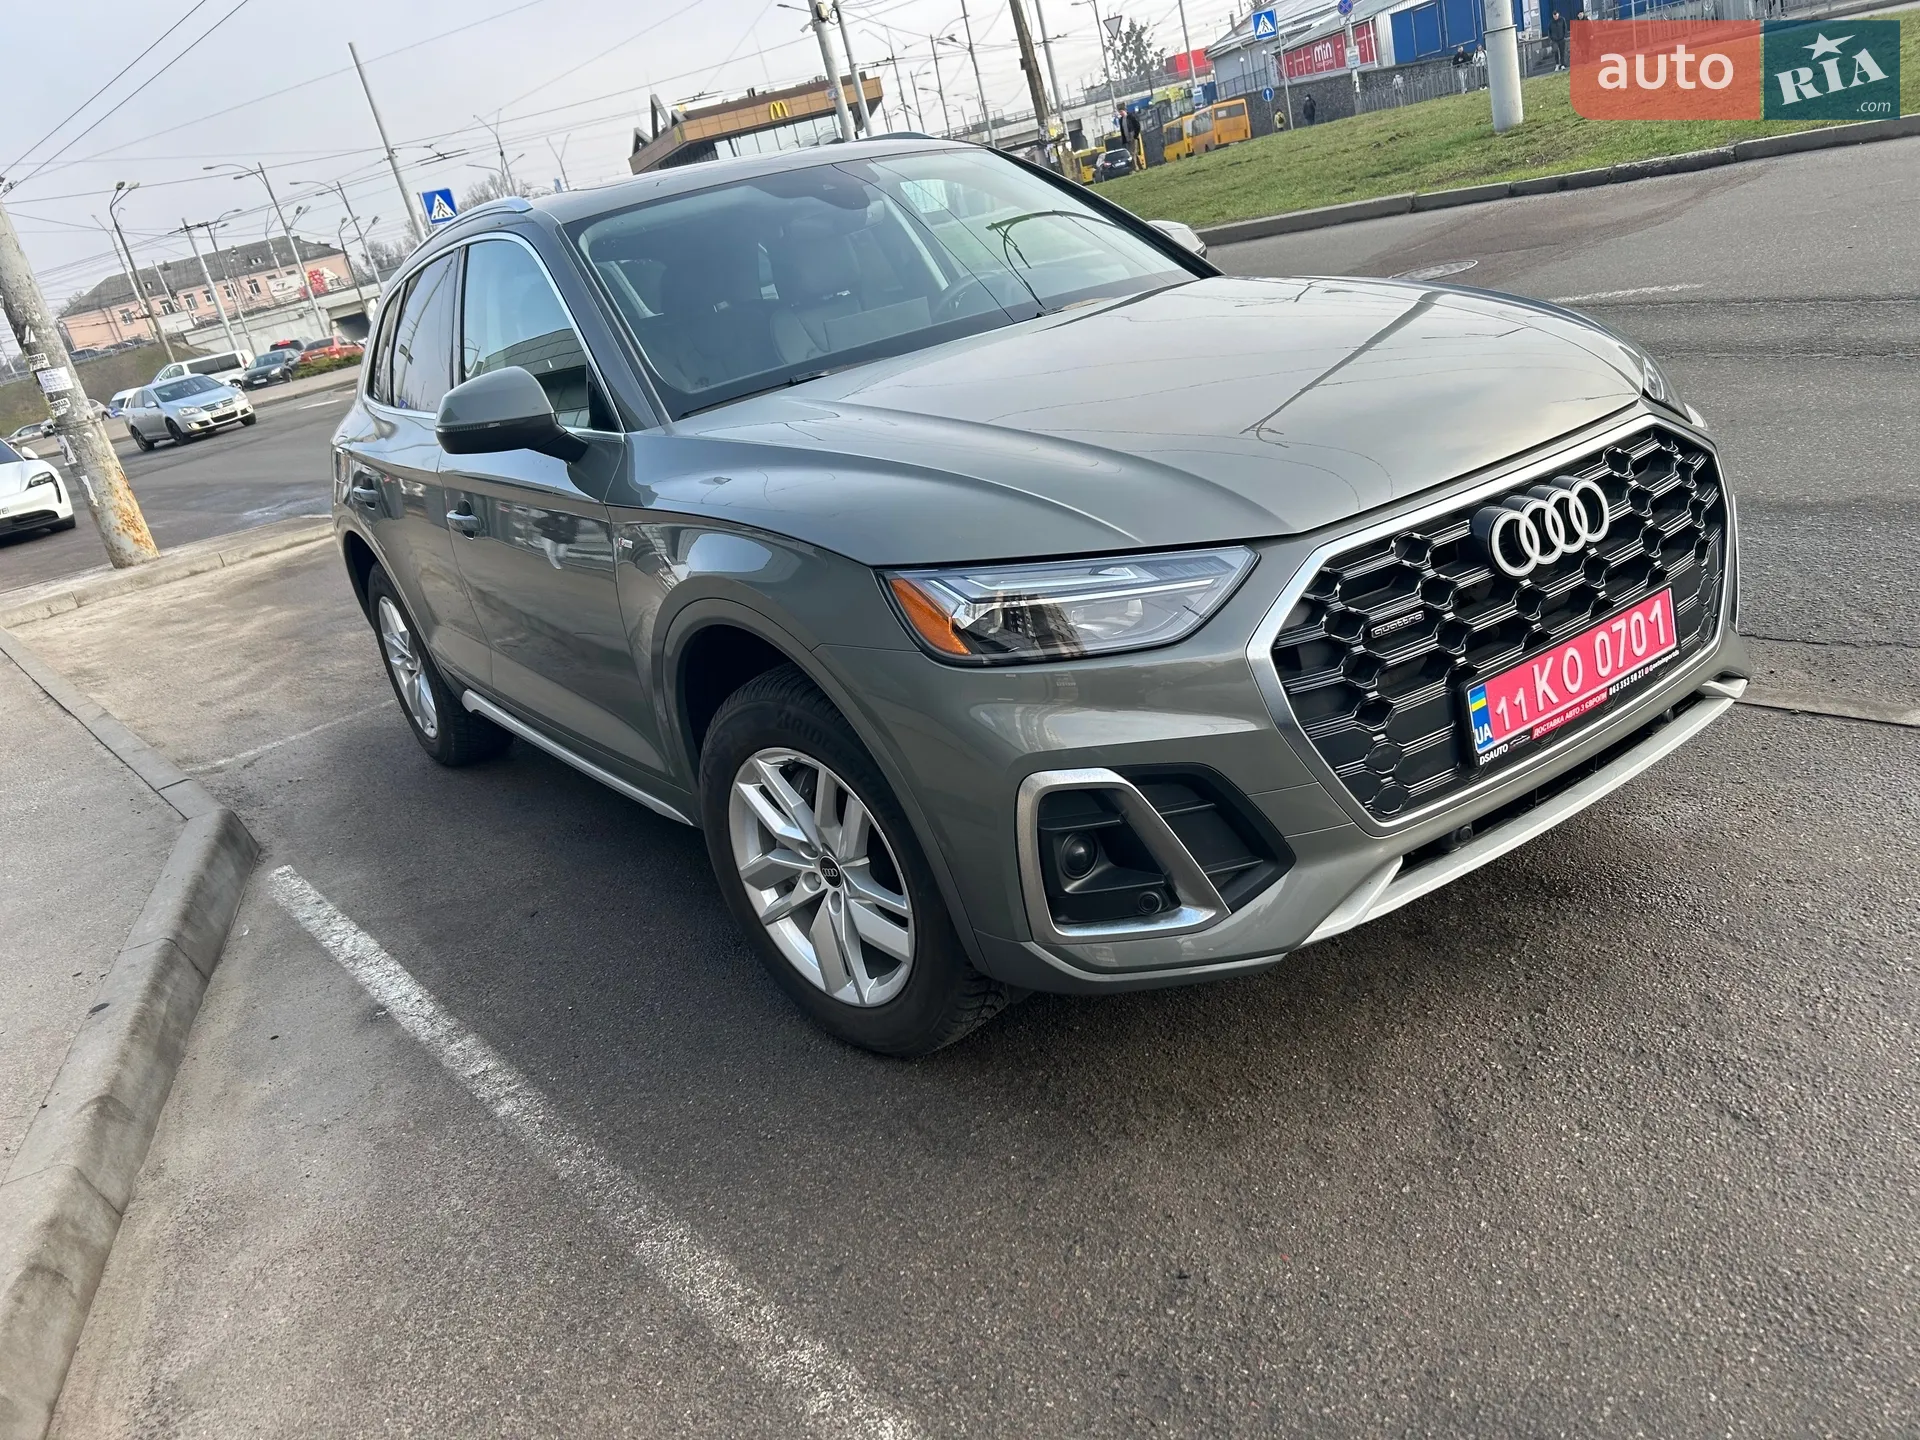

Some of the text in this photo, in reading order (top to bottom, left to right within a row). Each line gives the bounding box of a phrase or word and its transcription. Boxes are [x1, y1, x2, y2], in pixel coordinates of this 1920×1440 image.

[1374, 614, 1423, 636] quattro
[1594, 599, 1666, 678] 0701
[1475, 723, 1493, 745] UA
[1533, 715, 1565, 740] ДОСТАВКА
[1565, 706, 1580, 721] АВТО
[1479, 743, 1509, 766] DSAUTO
